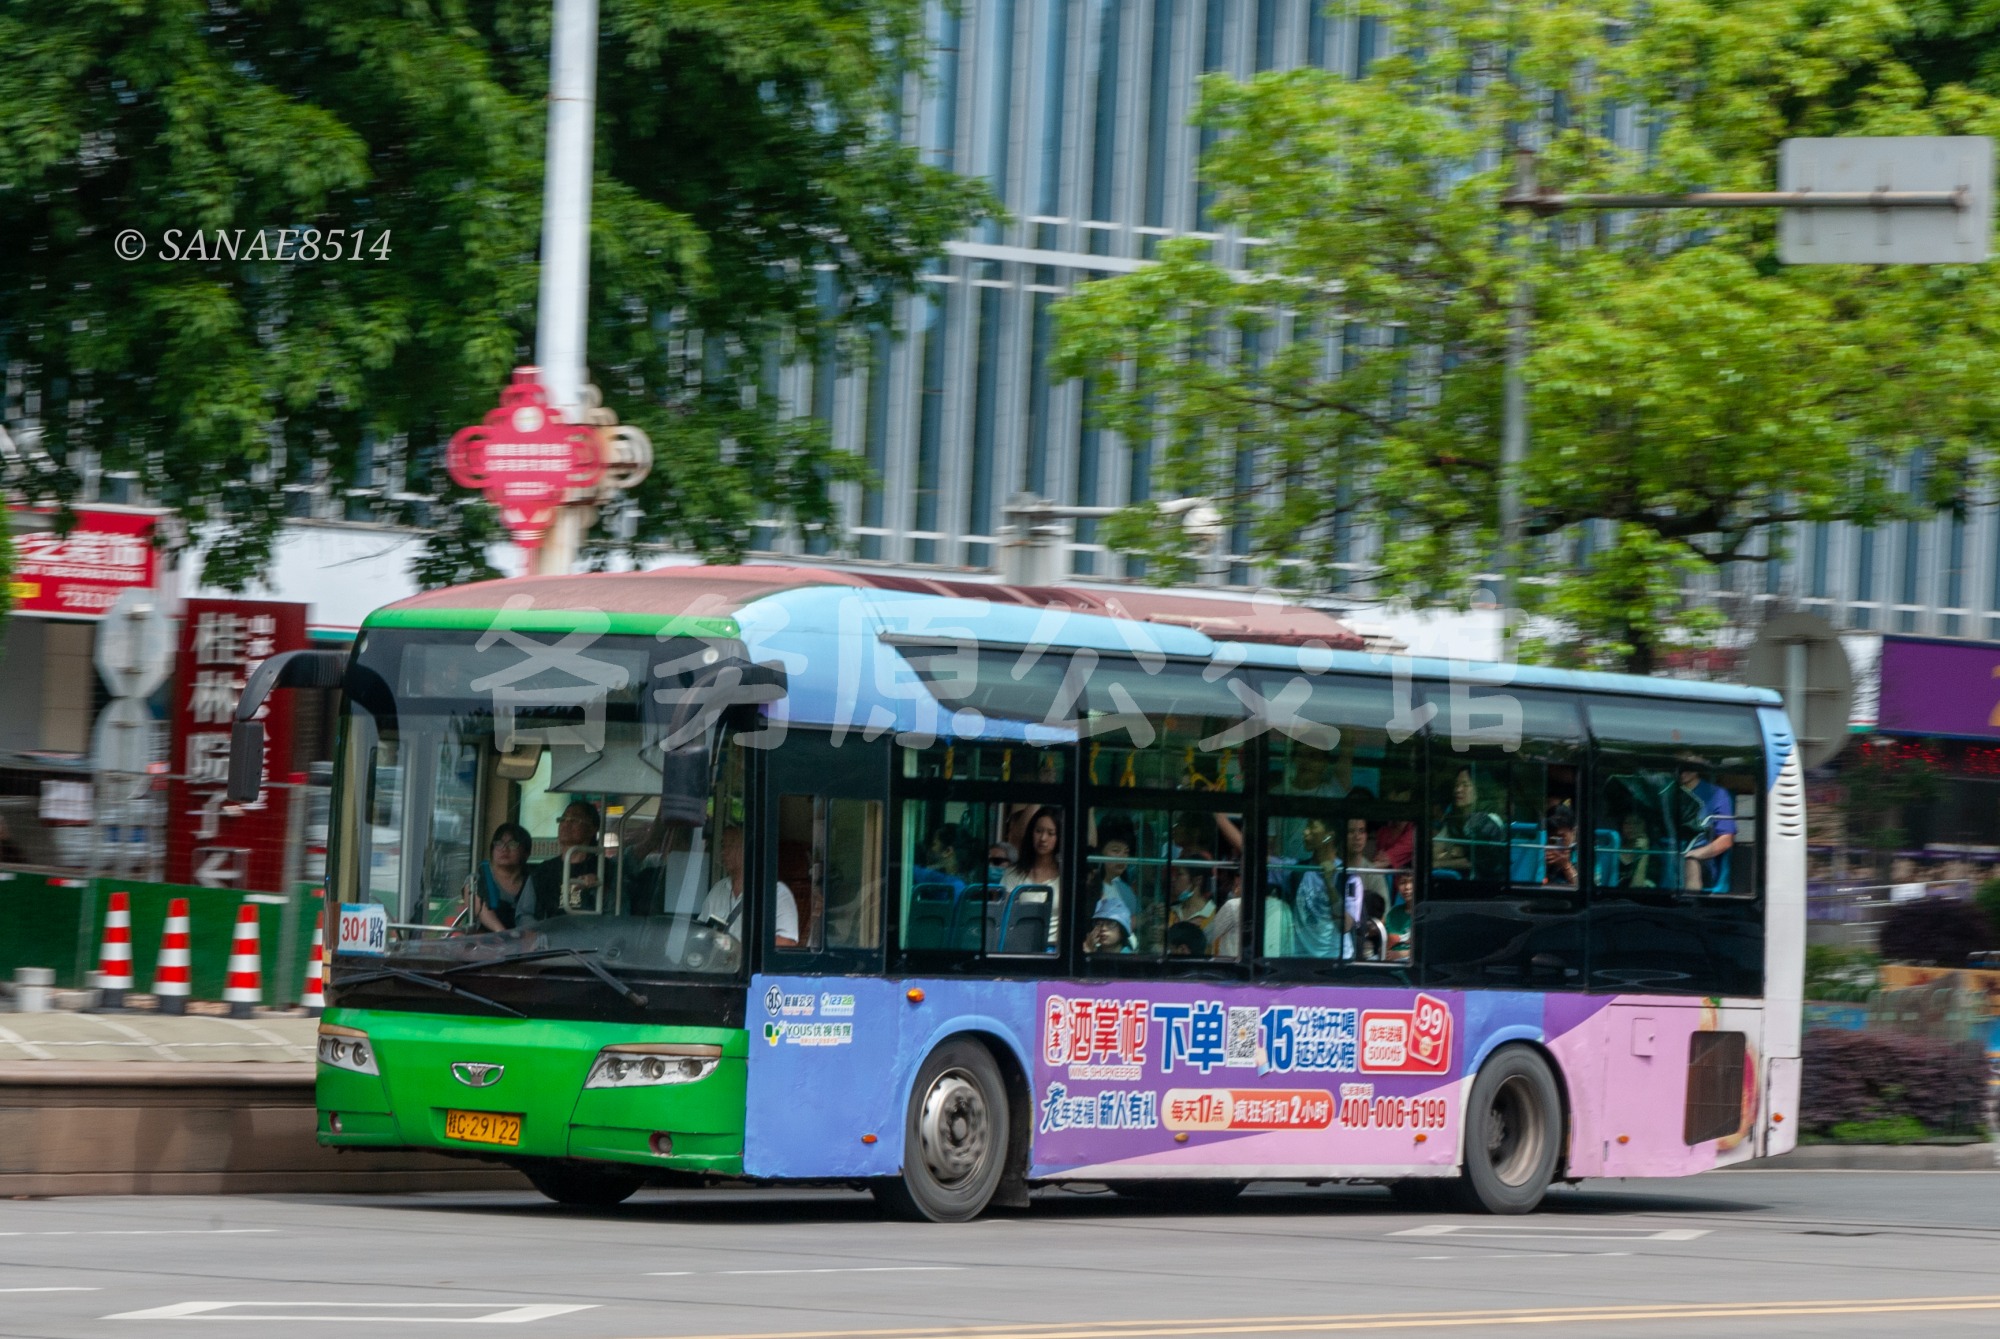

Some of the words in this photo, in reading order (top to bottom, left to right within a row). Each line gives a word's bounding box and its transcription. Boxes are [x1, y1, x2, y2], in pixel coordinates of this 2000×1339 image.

[342, 917, 384, 947] 301路
[1068, 1001, 1147, 1062] 酒掌柜
[1154, 1003, 1225, 1071] 下单
[1261, 1008, 1294, 1070] 15
[1100, 1094, 1156, 1126] 新人有礼
[1170, 1094, 1225, 1122] 每天17点
[1234, 1096, 1330, 1124] 疯狂折扣2小时
[1341, 1098, 1446, 1128] 400-006-6199
